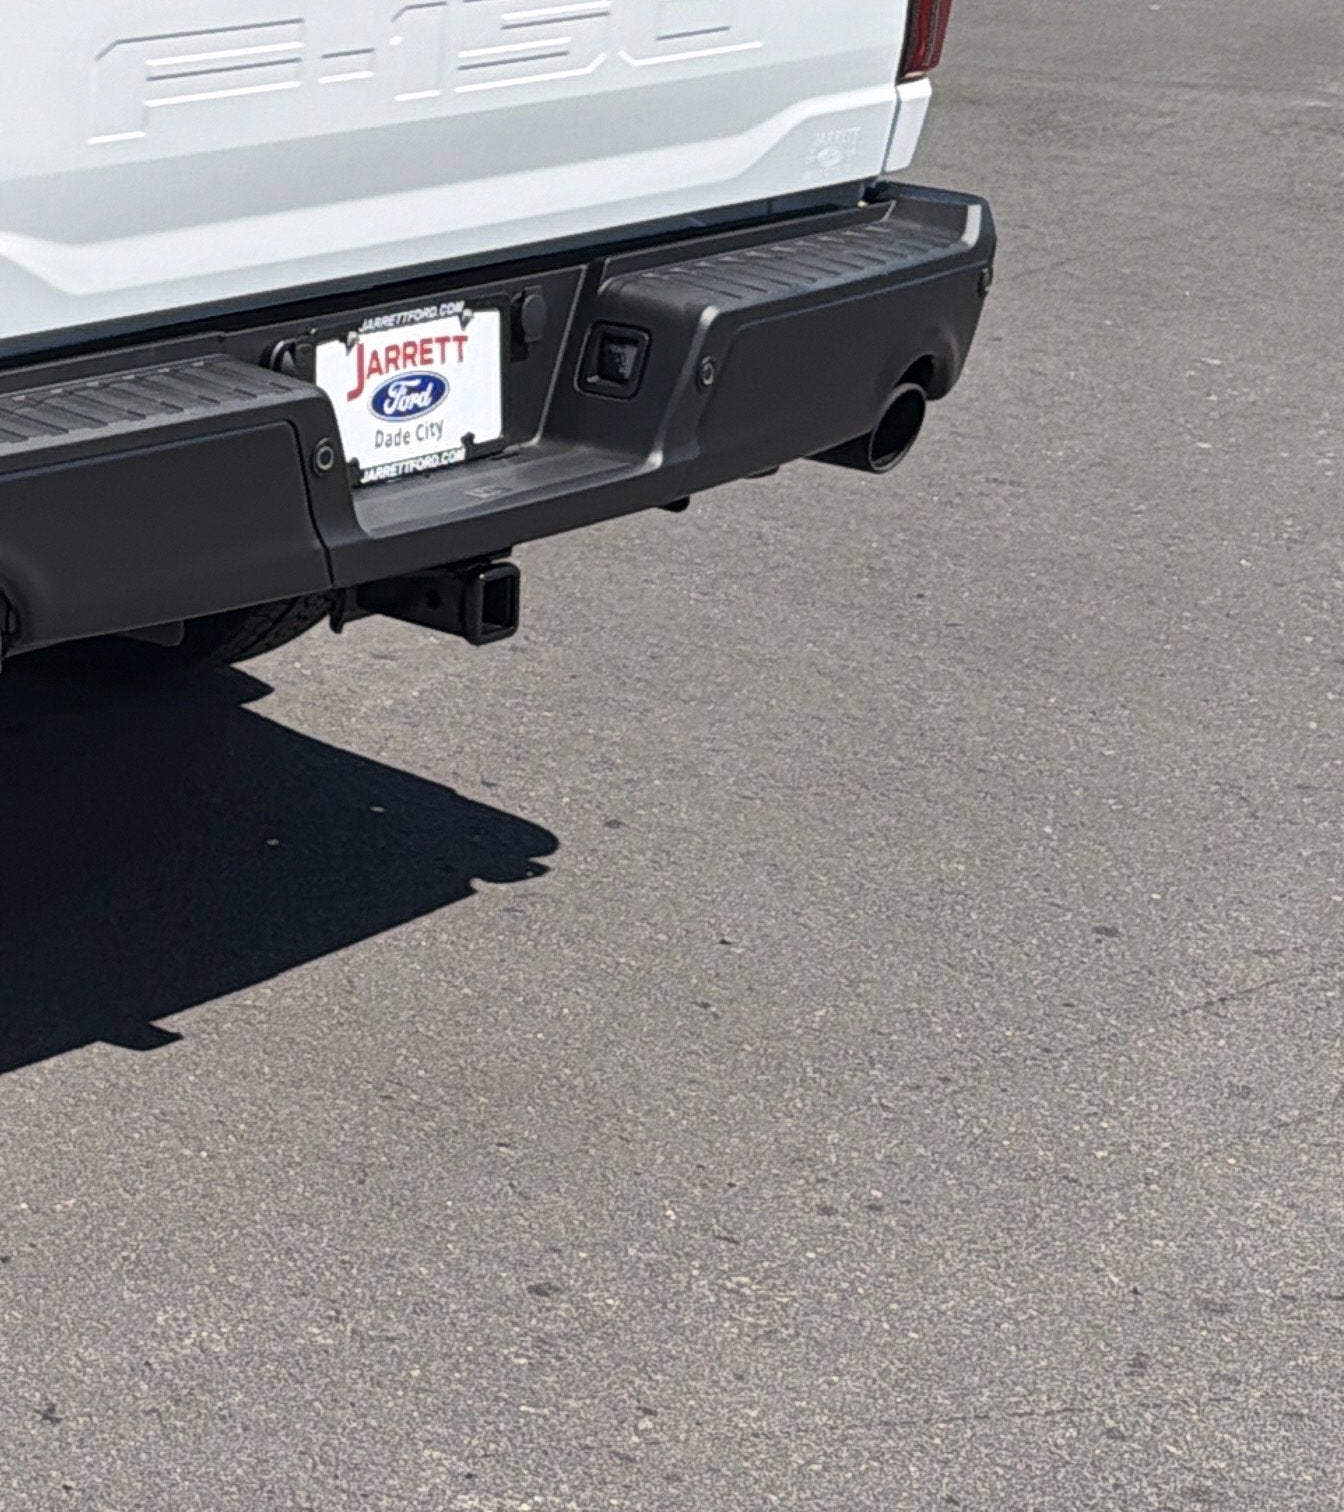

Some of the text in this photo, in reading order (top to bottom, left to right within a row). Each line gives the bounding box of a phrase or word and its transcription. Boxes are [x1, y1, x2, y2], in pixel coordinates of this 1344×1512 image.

[359, 301, 465, 331] JARRETTFORD.COM
[346, 335, 469, 402] JARRETT
[383, 379, 434, 415] Ford
[375, 420, 444, 448] Dade City
[361, 449, 465, 482] JARRETTFORD.COM
